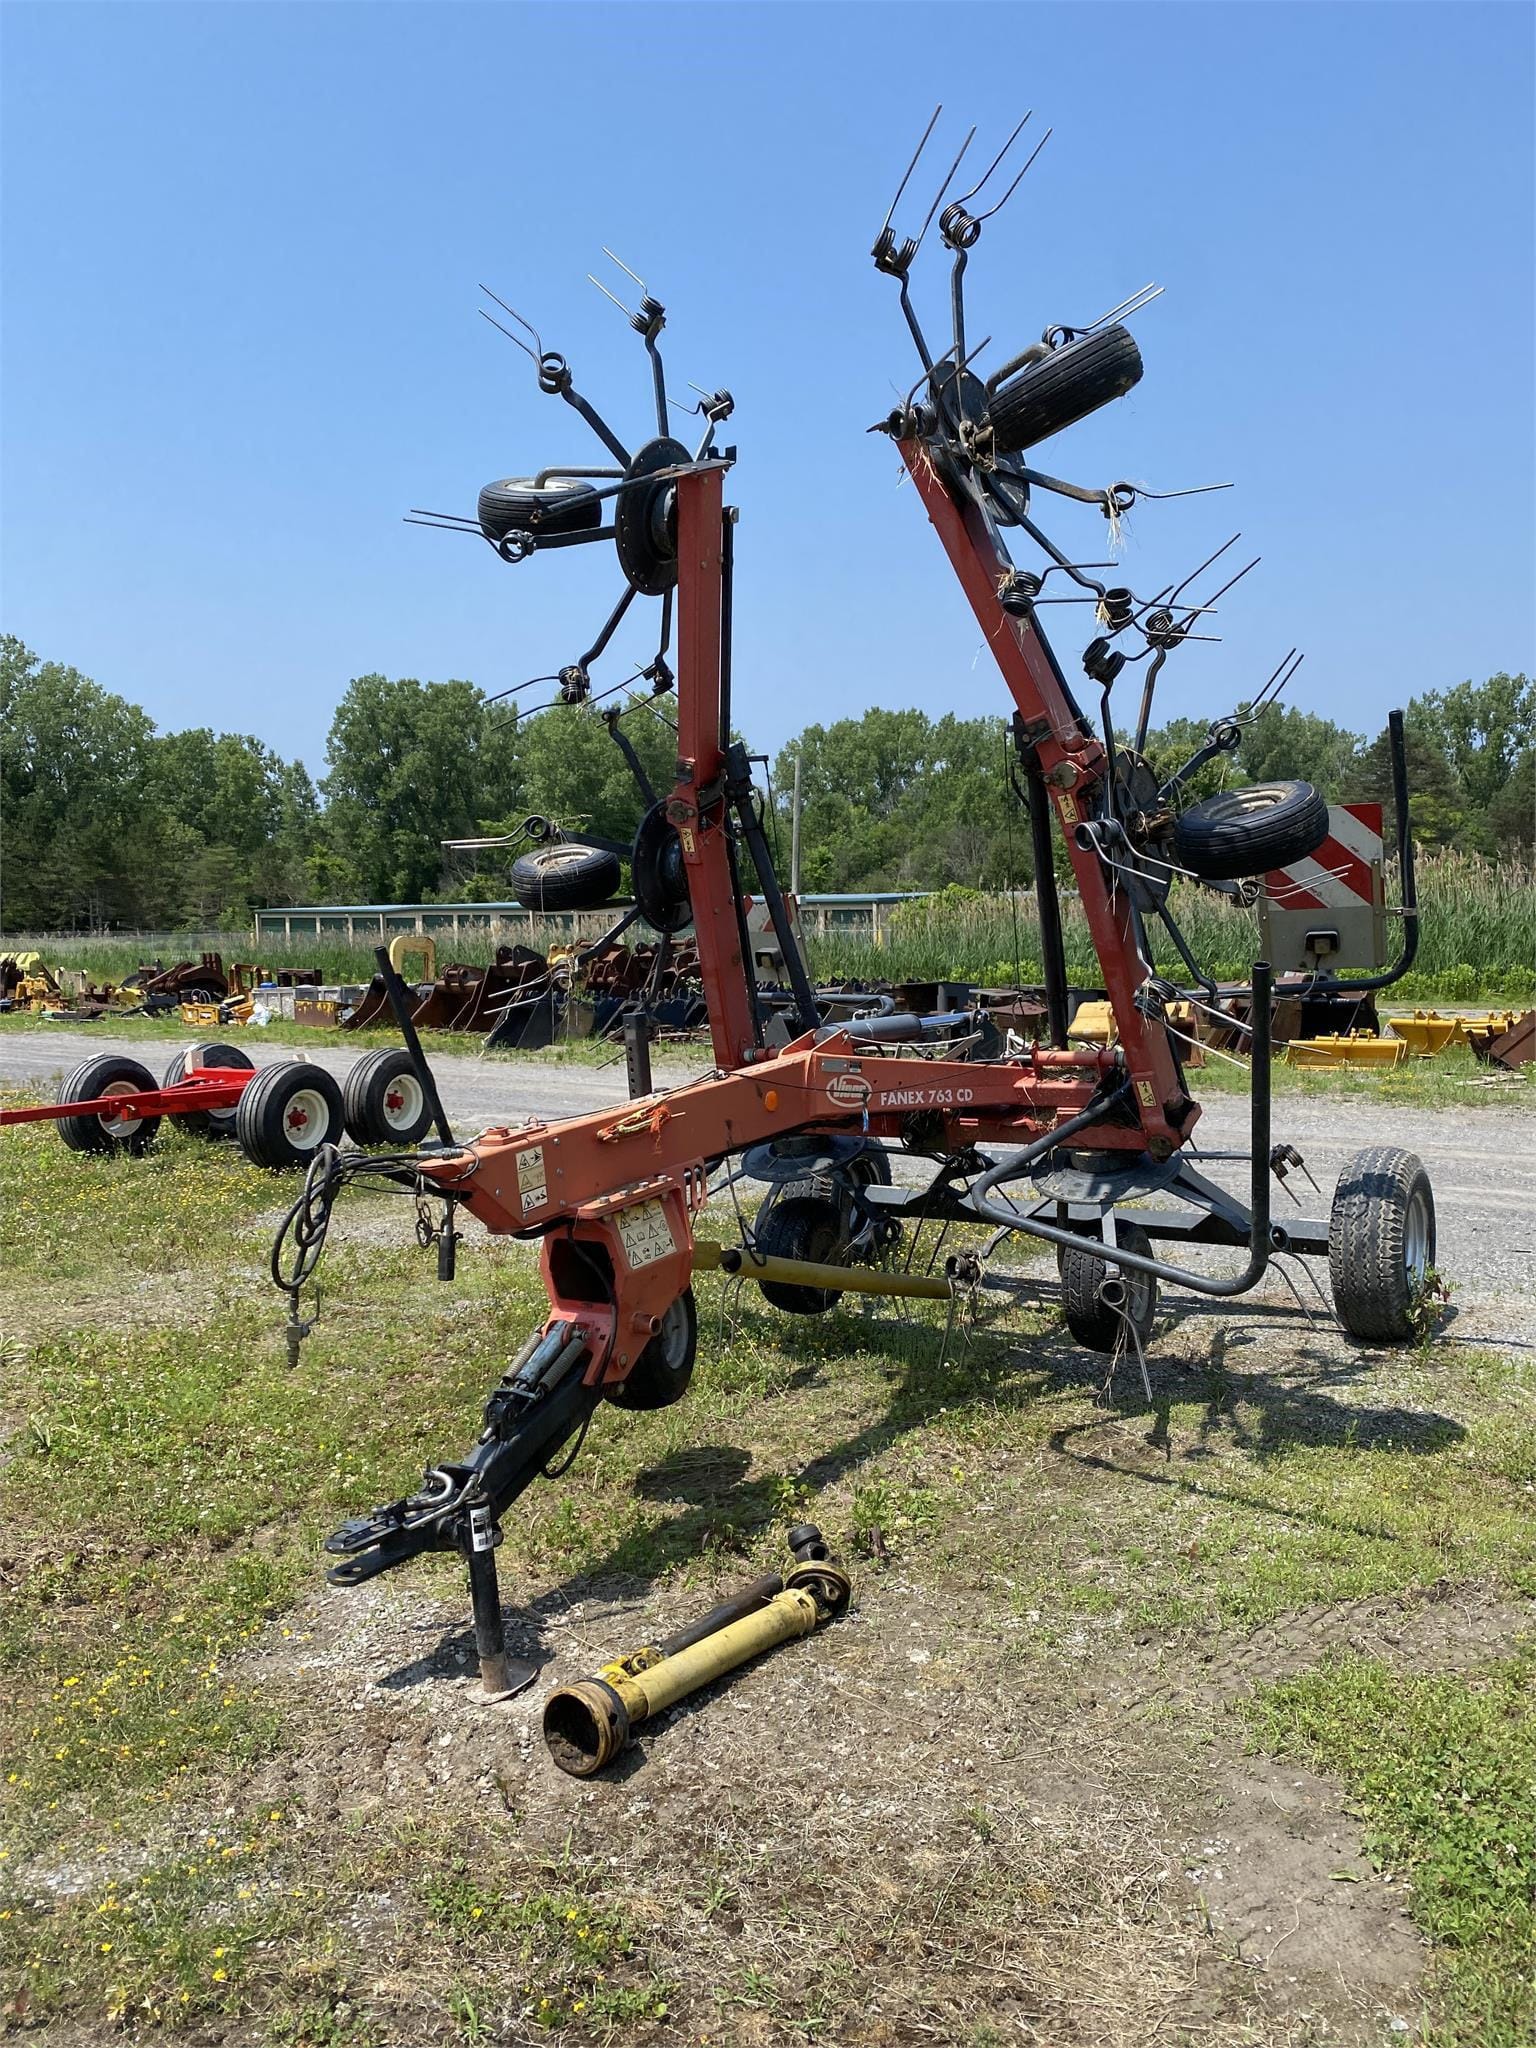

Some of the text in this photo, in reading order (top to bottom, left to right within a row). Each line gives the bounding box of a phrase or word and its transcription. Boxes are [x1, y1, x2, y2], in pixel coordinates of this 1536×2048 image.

[880, 1088, 973, 1106] FANEX 763 CD
